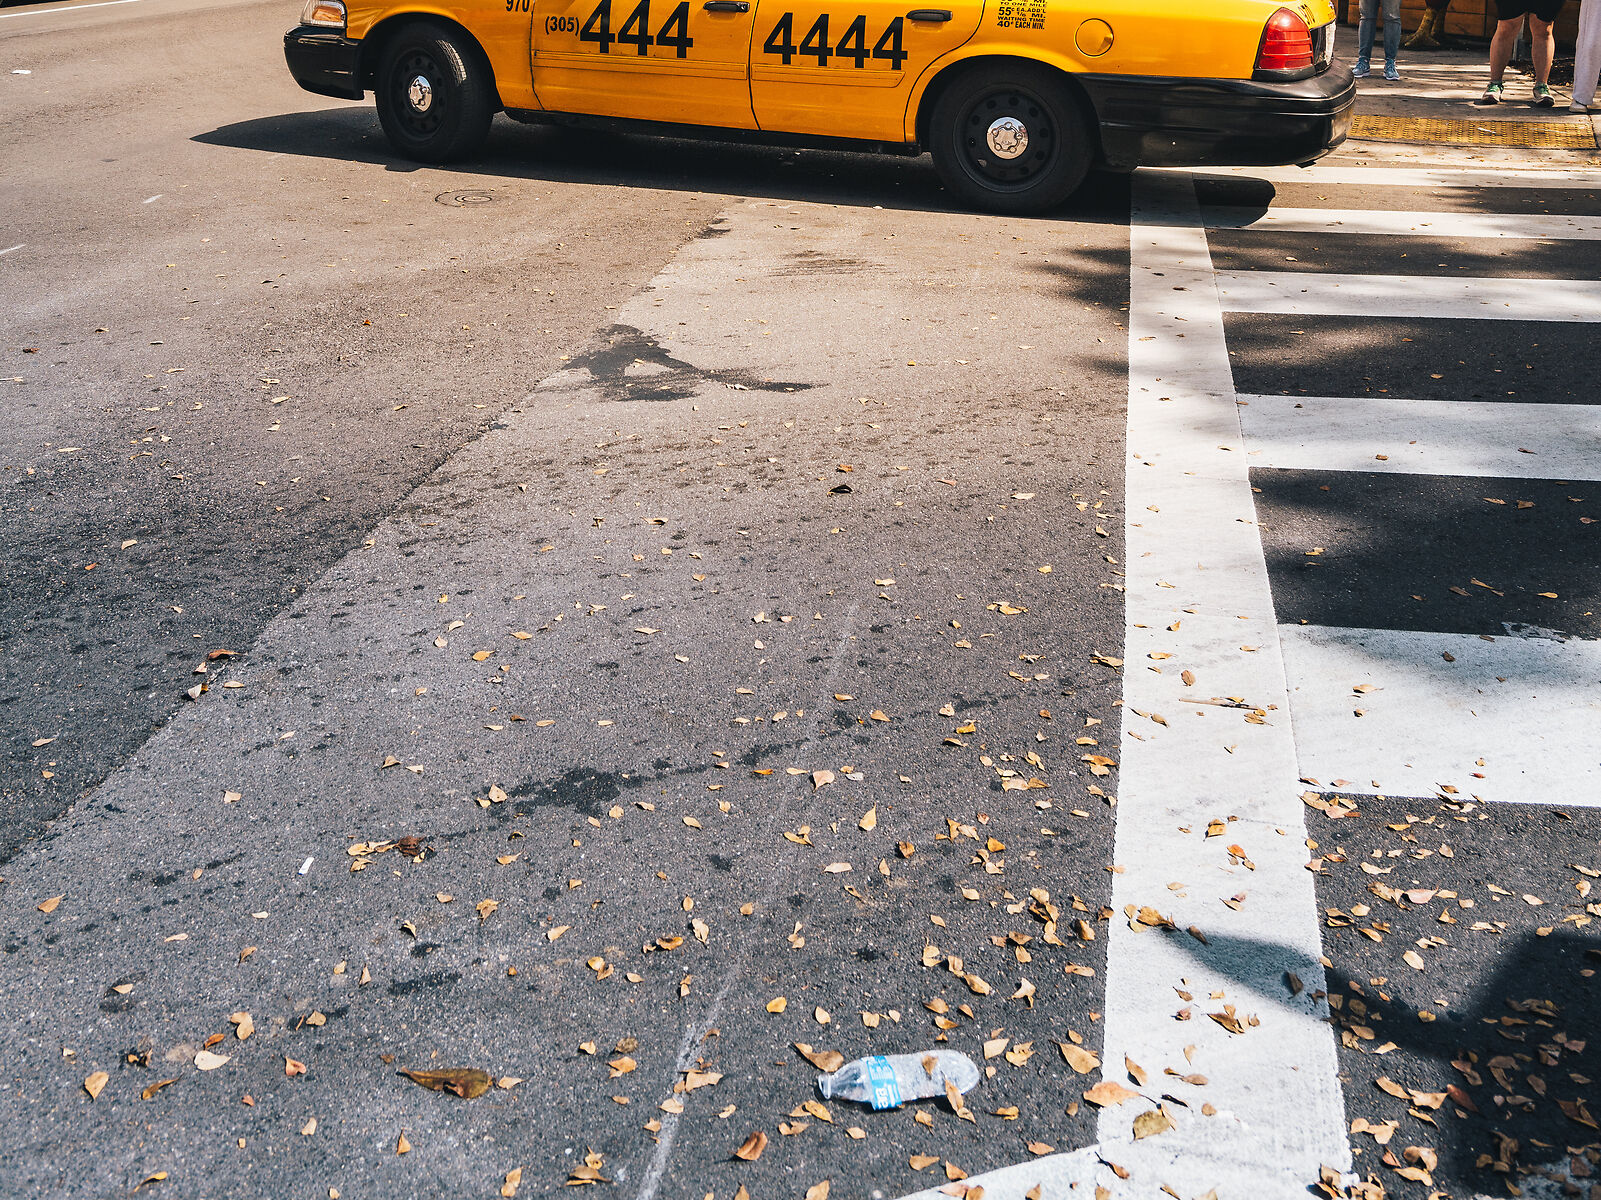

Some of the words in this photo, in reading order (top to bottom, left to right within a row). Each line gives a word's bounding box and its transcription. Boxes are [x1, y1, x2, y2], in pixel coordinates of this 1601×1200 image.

[545, 16, 580, 36] (305)
[1015, 21, 1031, 29] EACH
[1031, 22, 1045, 30] MIN.
[763, 12, 908, 71] 4444
